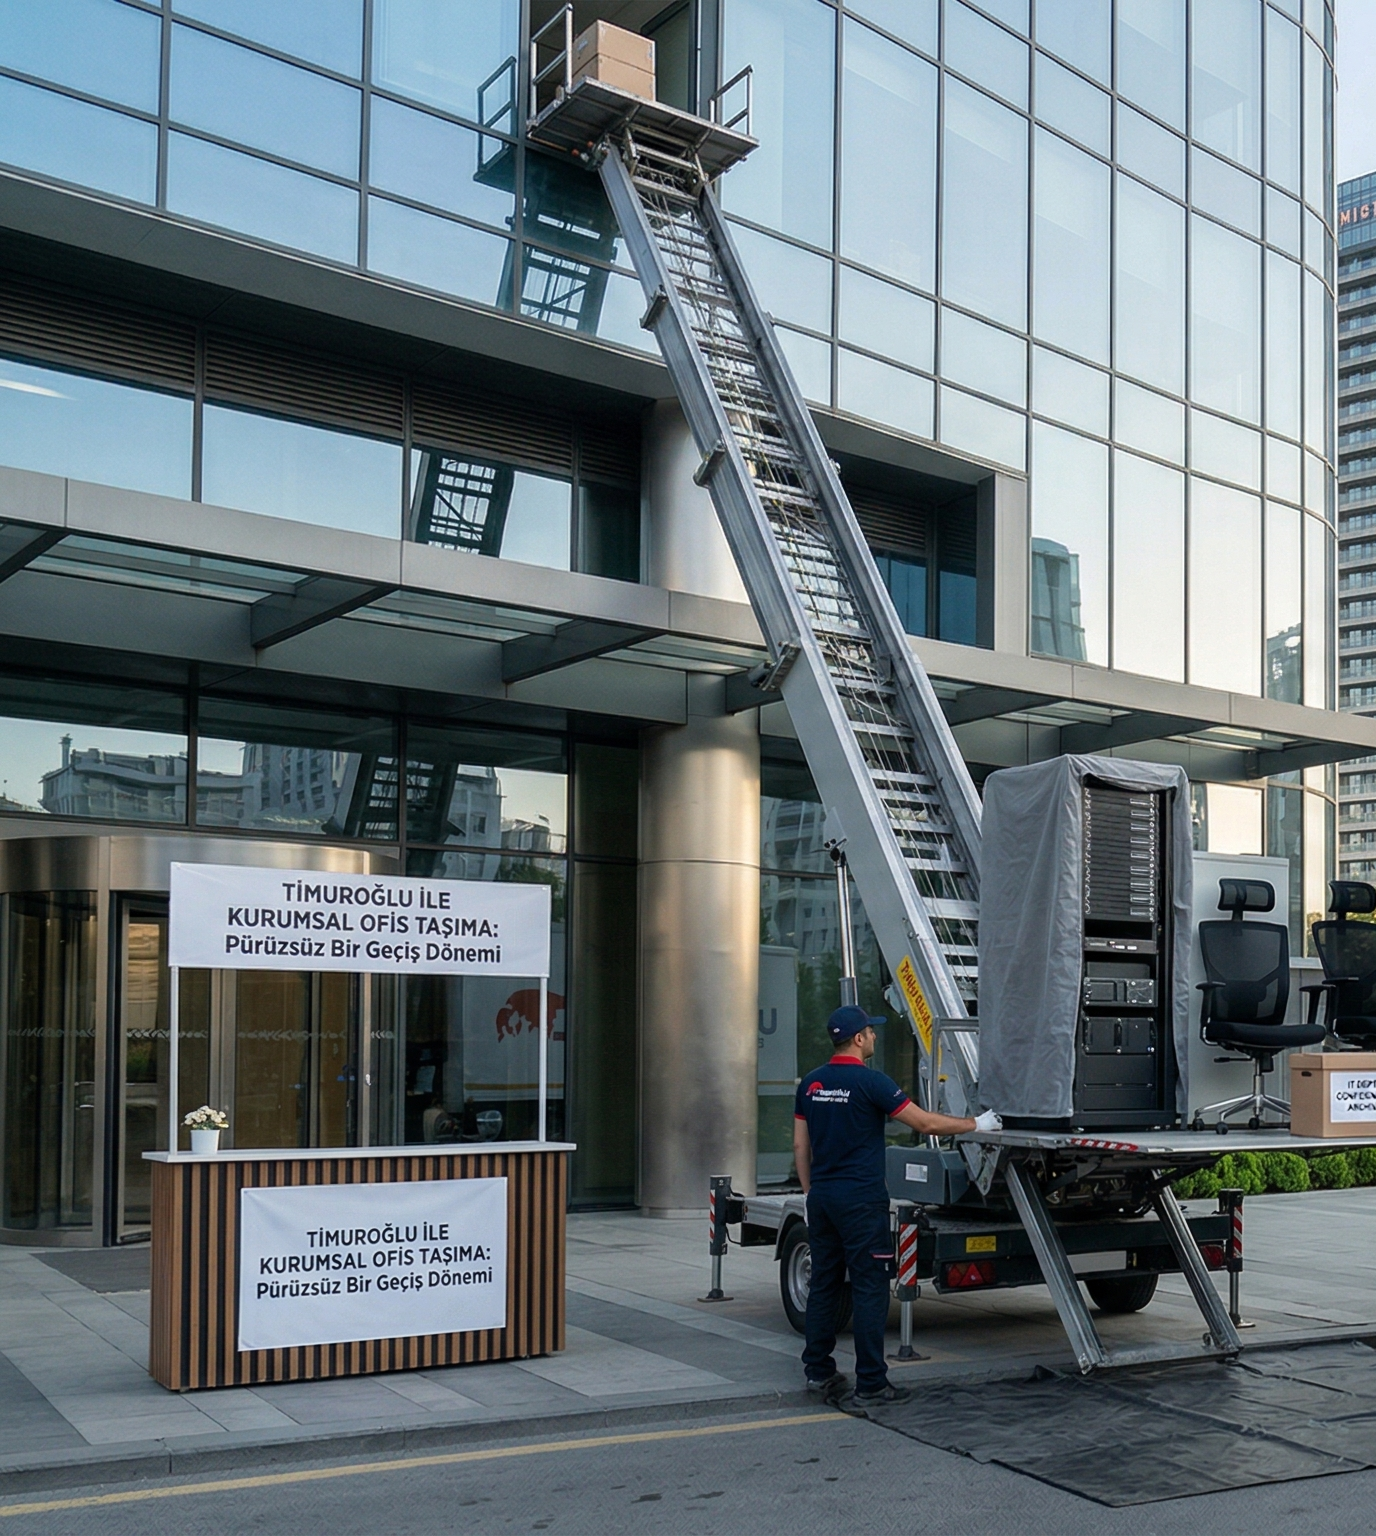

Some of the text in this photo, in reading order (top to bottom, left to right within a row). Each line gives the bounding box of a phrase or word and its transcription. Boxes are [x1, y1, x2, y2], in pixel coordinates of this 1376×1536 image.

[282, 879, 451, 909] TİMUROĞLU İLE
[227, 906, 499, 939] KURUMSAL OFİS TAŞIMA:
[225, 934, 502, 963] Pürüzsüz Bir Geçiş Dönemi
[306, 1222, 449, 1248] TİMUROĞLU İLE
[260, 1245, 491, 1275] KURUMSAL OFİS TAŞIMA:
[256, 1267, 493, 1299] Pürüzsüz Bir Geçiş Dönemi
